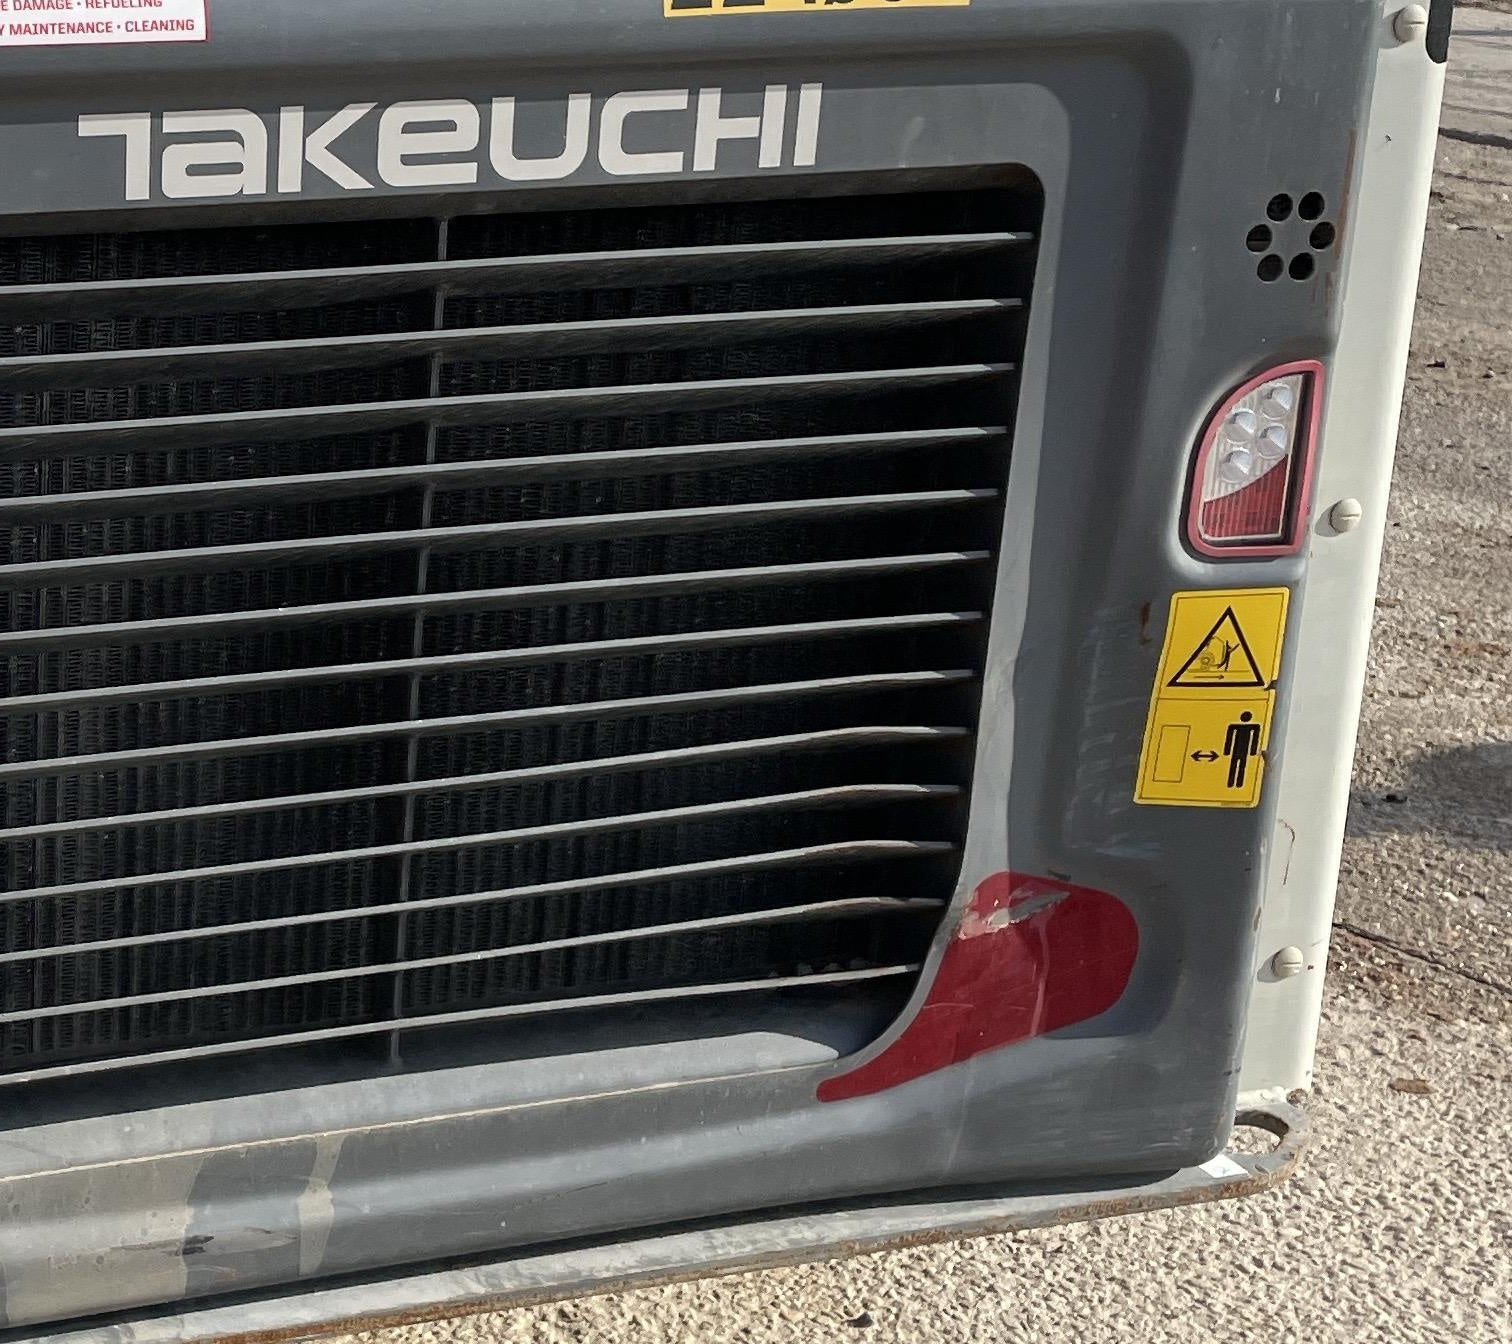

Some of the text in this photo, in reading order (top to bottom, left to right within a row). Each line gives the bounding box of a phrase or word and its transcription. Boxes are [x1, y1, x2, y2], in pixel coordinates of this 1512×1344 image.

[9, 20, 113, 36] MAINTENANCE
[125, 18, 195, 33] CLEANING
[77, 82, 823, 201] TAKEUCHI
